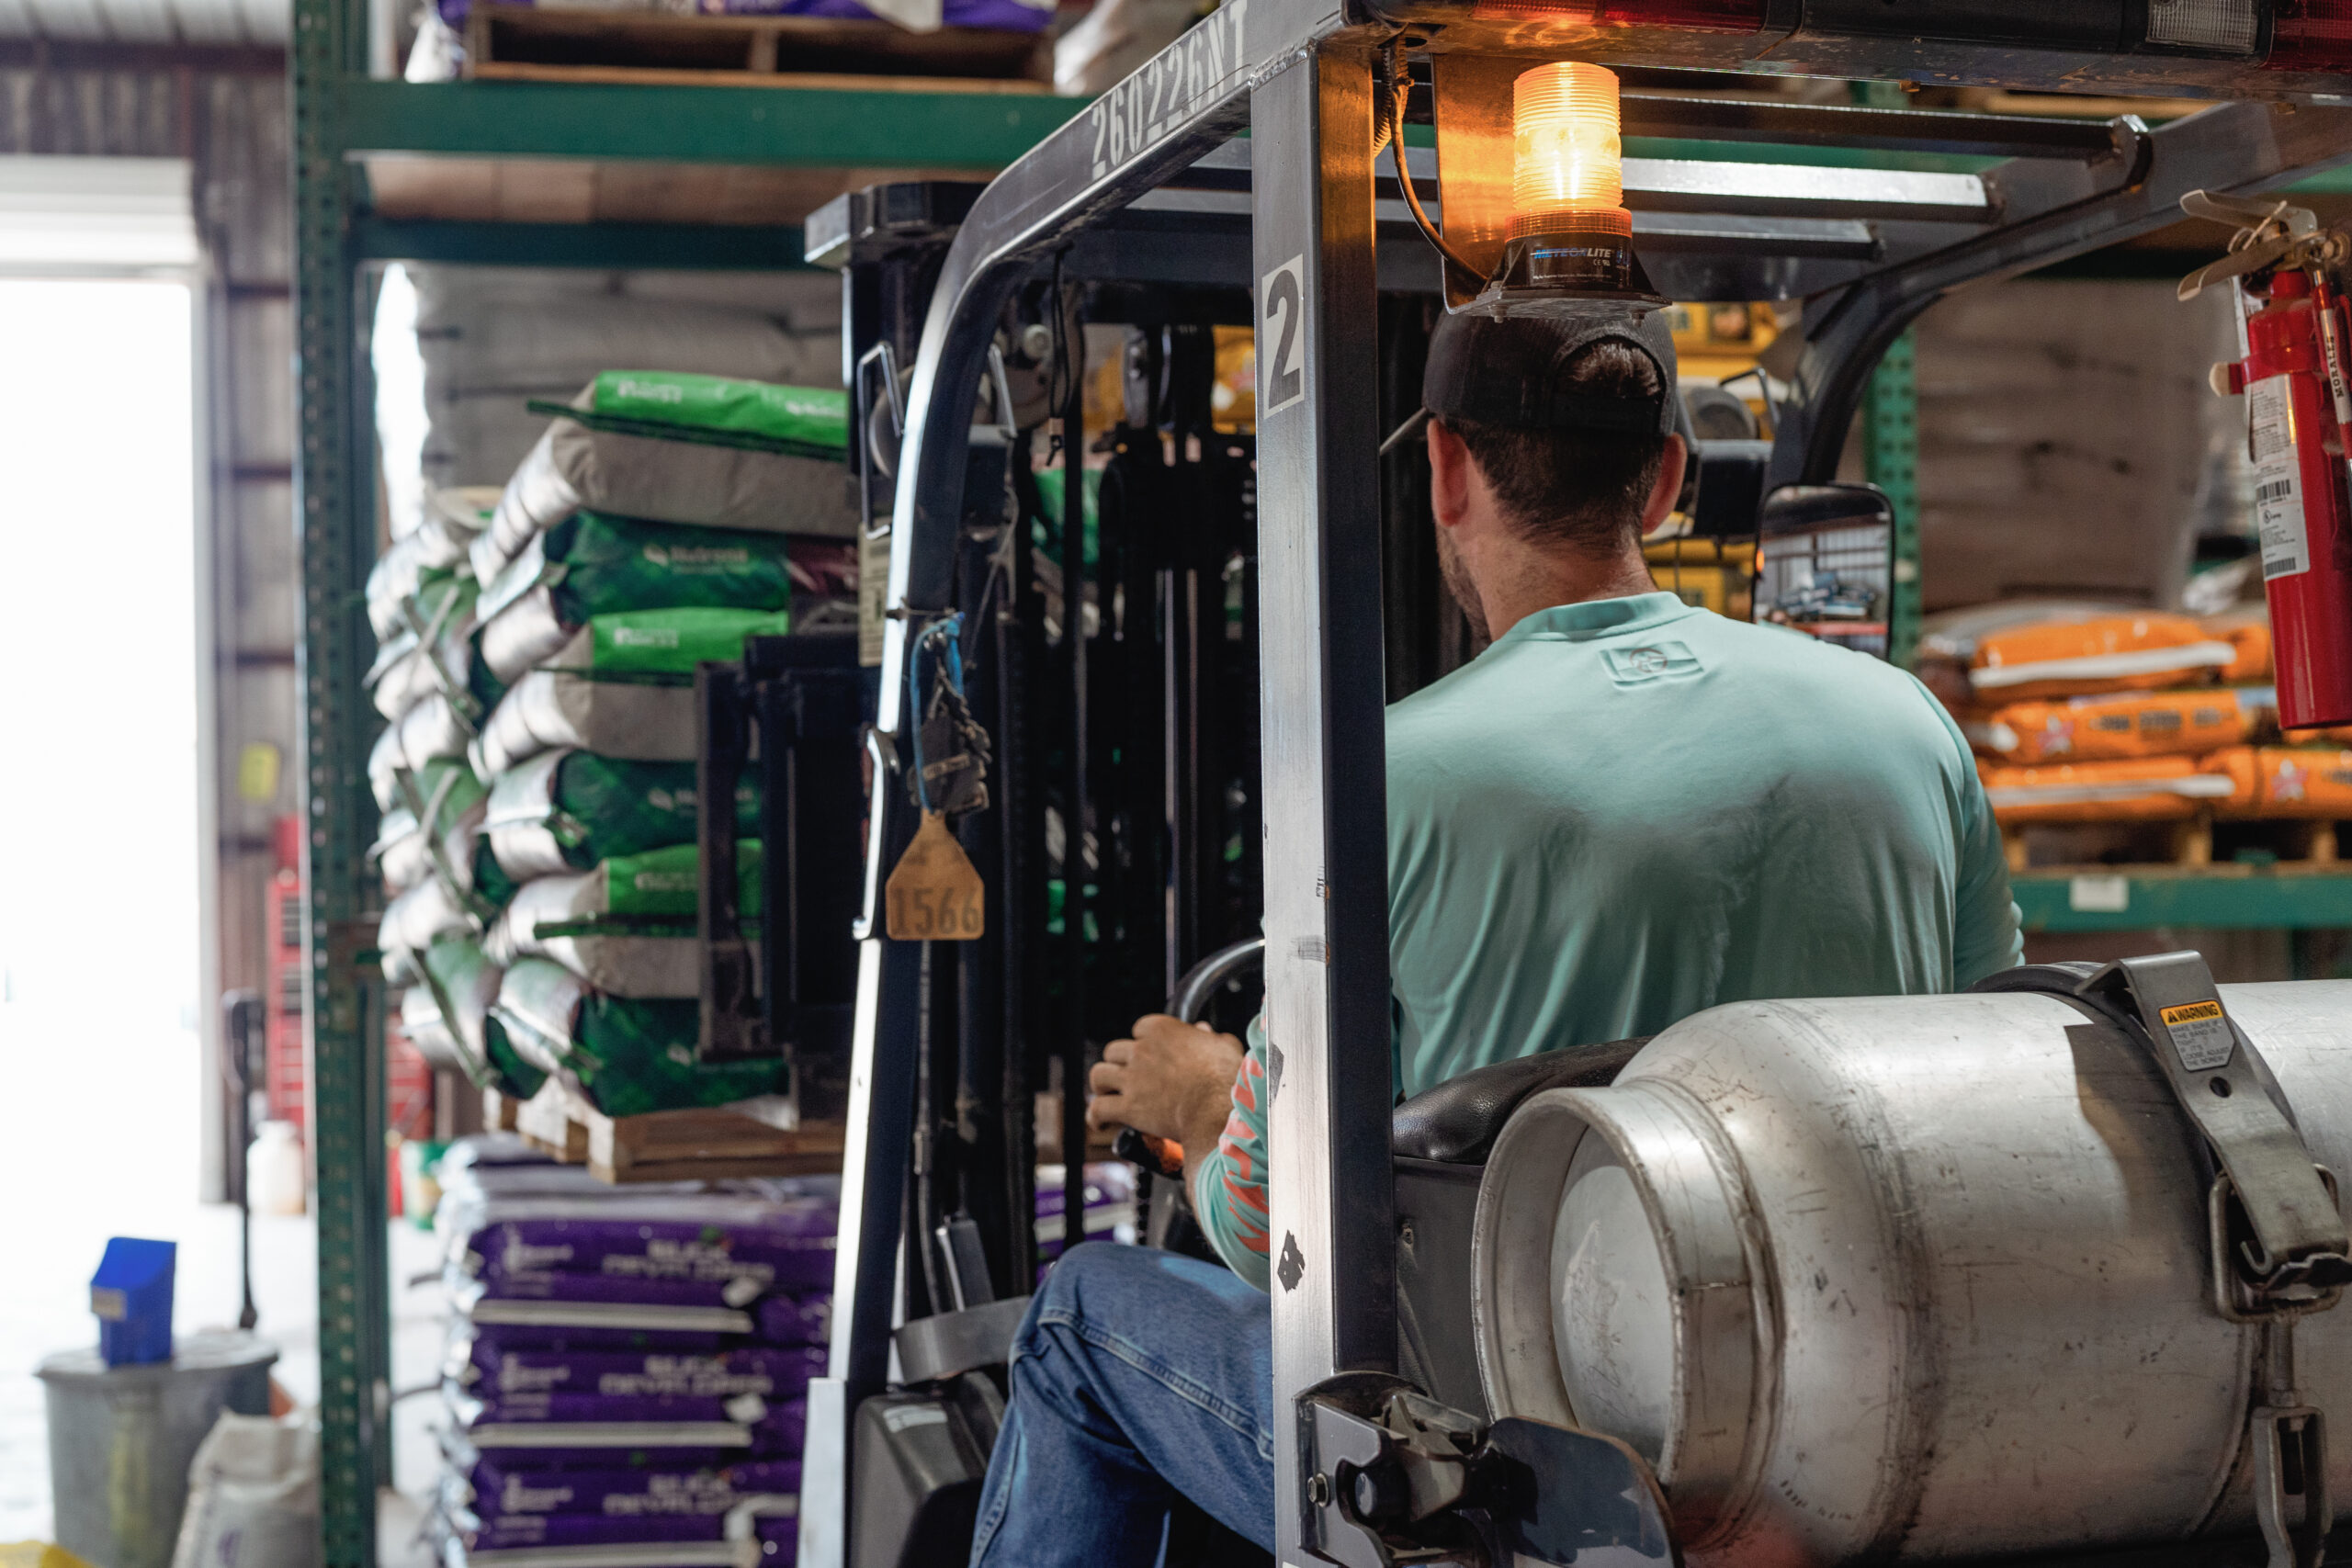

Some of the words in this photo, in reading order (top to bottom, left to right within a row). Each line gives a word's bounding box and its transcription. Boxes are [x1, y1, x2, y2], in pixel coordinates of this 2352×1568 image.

[1091, 0, 1247, 181] 260226NT
[1267, 269, 1301, 411] 2
[2326, 336, 2344, 397] MORALES
[891, 886, 979, 935] 1566
[2175, 1004, 2219, 1021] WARNING
